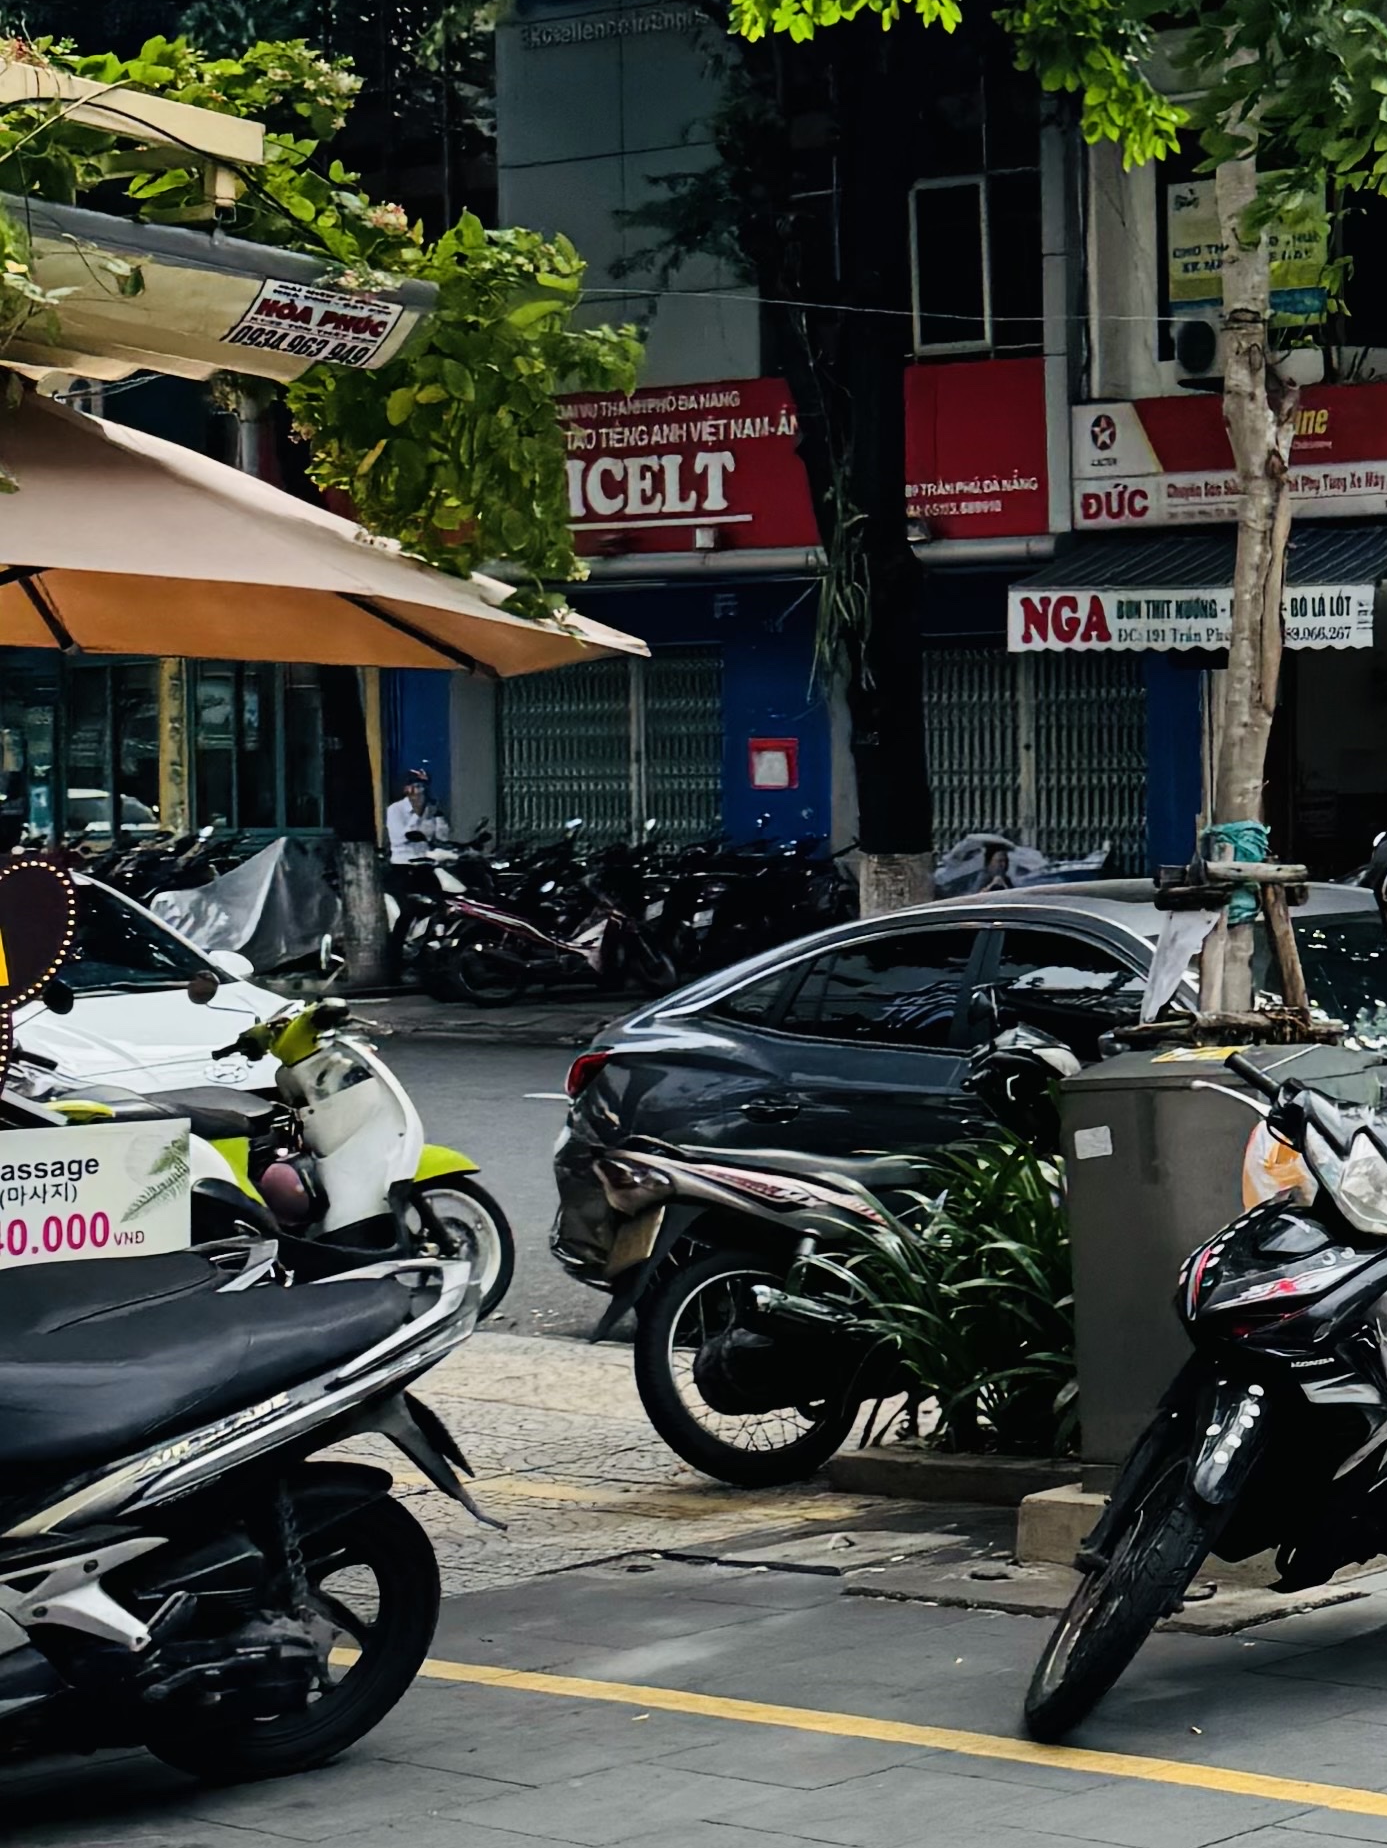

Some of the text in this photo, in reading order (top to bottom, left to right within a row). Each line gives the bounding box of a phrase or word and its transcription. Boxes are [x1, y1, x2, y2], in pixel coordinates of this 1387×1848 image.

[254, 298, 314, 325] HÒA
[316, 311, 387, 338] PHÚC
[324, 343, 371, 365] 949
[651, 423, 688, 446] ANH
[690, 415, 728, 447] VIỆT
[1082, 484, 1149, 521] ĐỨC
[1021, 594, 1112, 644] NGA
[1146, 628, 1167, 642] 191
[0, 1157, 100, 1182] assage
[0, 1182, 78, 1211] (마사지)
